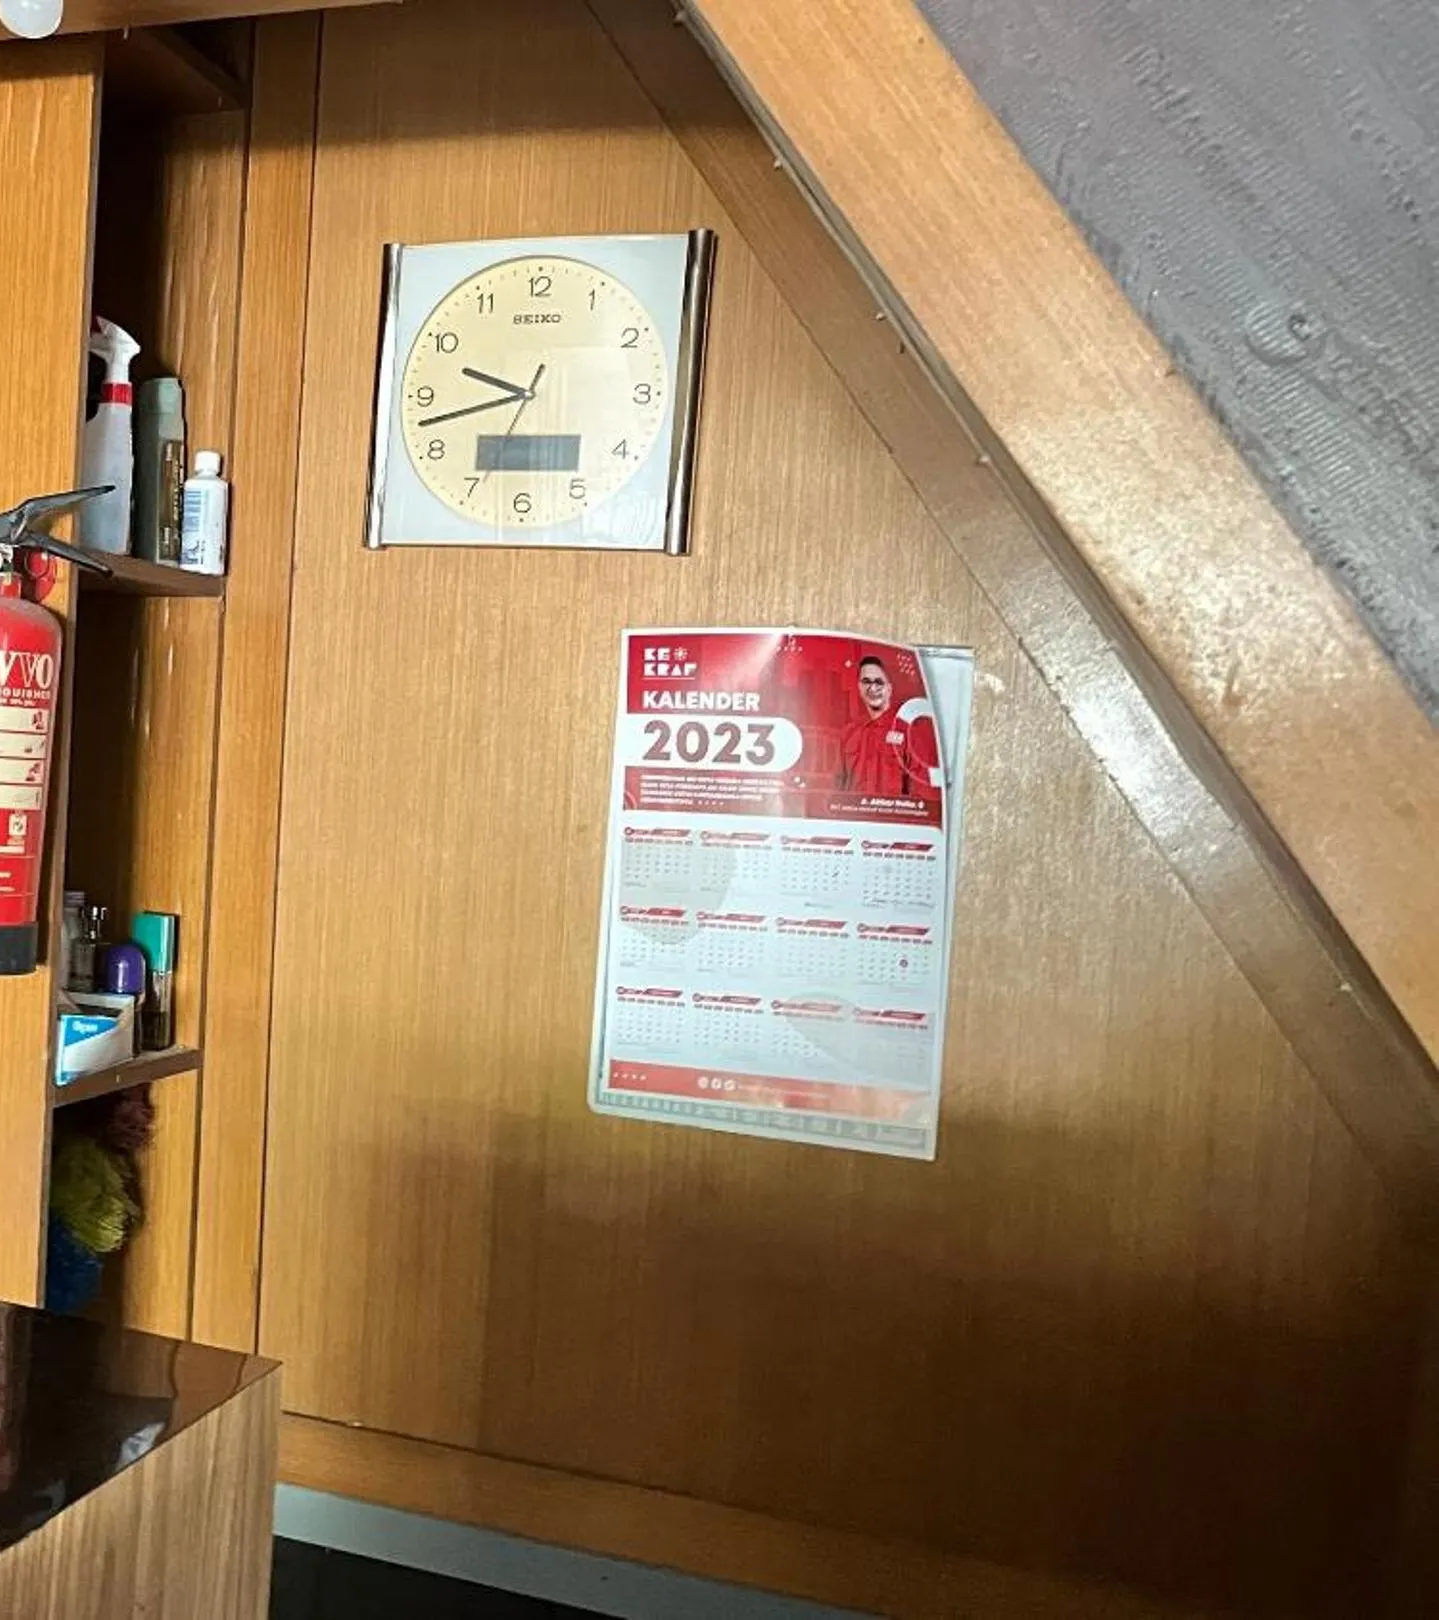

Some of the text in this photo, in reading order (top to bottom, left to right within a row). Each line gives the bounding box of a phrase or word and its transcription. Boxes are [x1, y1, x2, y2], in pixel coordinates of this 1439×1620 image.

[528, 275, 553, 297] 12
[476, 293, 494, 314] 11
[588, 289, 597, 311] 1
[512, 314, 561, 325] SEIKO
[435, 332, 459, 354] 10
[620, 327, 640, 349] 2
[417, 386, 434, 407] 9
[633, 383, 651, 405] 3
[427, 439, 445, 460] 8
[611, 438, 630, 460] 4
[463, 476, 480, 498] 7
[569, 478, 586, 499] 5
[513, 492, 532, 513] 6
[643, 662, 698, 676] KRAF
[642, 690, 761, 712] KALENDER
[642, 719, 776, 766] 2023
